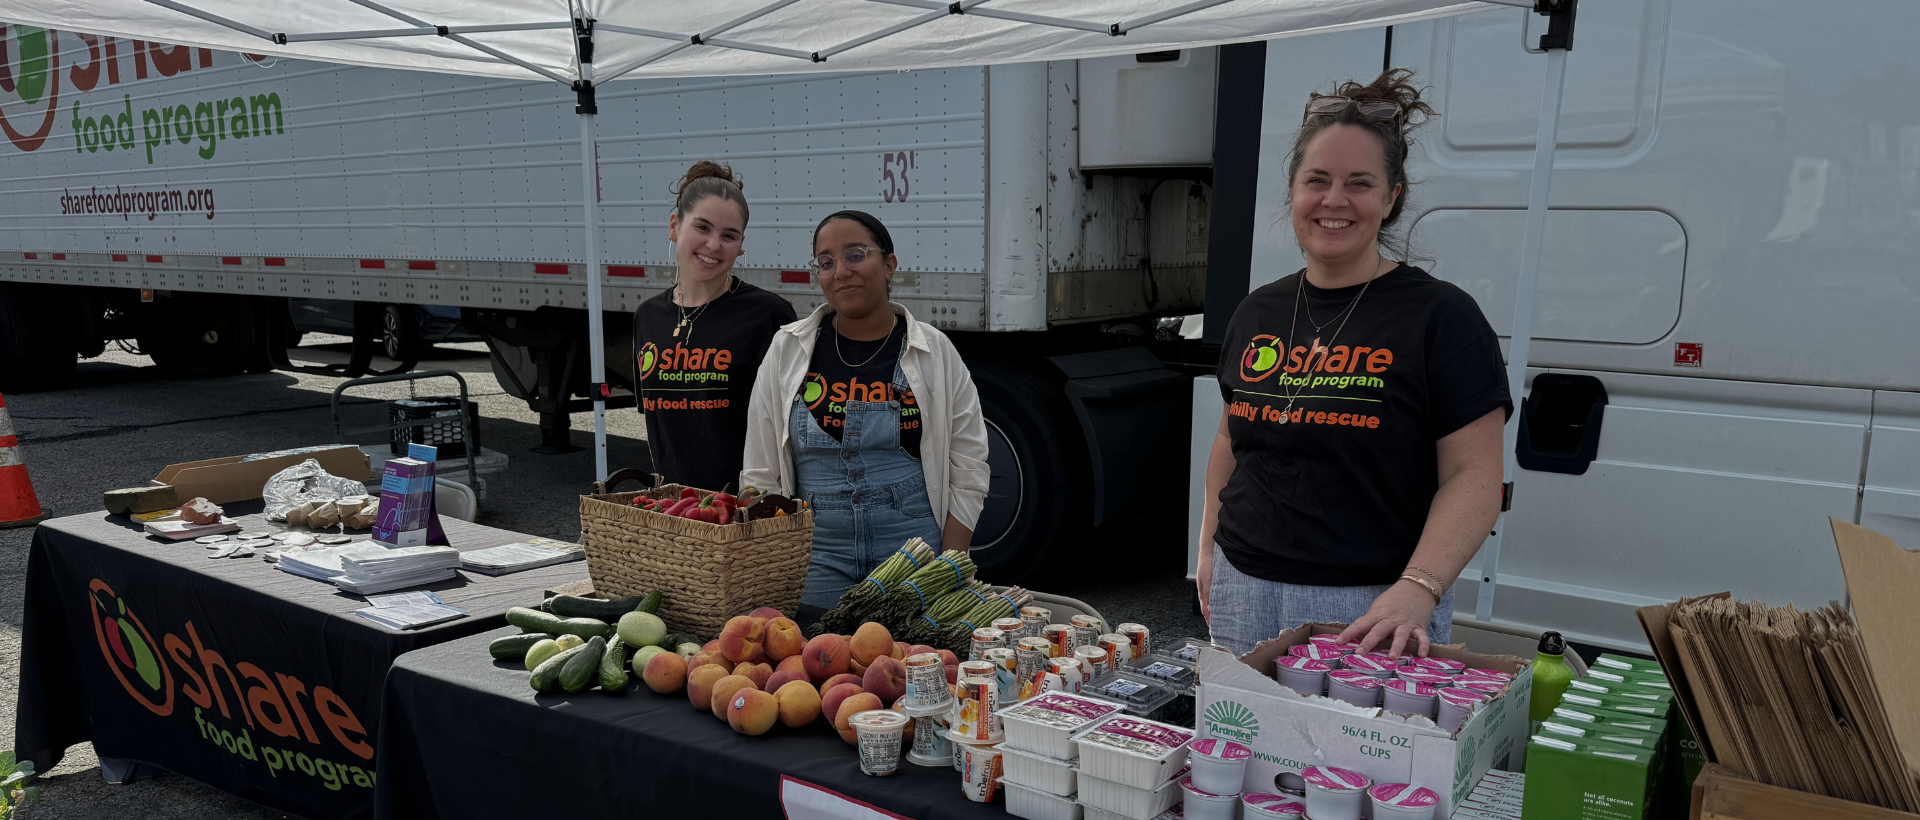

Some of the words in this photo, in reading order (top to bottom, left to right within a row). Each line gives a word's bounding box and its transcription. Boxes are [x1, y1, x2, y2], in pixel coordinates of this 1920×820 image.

[72, 94, 136, 153] food
[142, 92, 284, 165] program
[883, 150, 914, 203] 53'
[60, 185, 215, 221] sharefoodprogram.org
[659, 342, 732, 370] share
[1283, 337, 1394, 373] share
[659, 370, 683, 381] food
[684, 371, 729, 383] program
[1279, 372, 1312, 387] food
[1311, 375, 1385, 389] program
[657, 398, 688, 410] food
[690, 399, 730, 410] rescue
[828, 401, 847, 414] fo
[823, 416, 846, 427] Fo
[1305, 410, 1380, 429] rescue
[163, 620, 374, 760] share
[194, 706, 258, 762] food
[1211, 723, 1251, 740] Ardmore
[1342, 725, 1367, 739] 96/4
[1370, 731, 1386, 743] FL.
[1389, 735, 1411, 749] OZ.
[1359, 744, 1391, 760] CUPS
[1584, 791, 1596, 799] Not
[1606, 797, 1634, 807] coconuts
[1594, 799, 1612, 807] alike.
